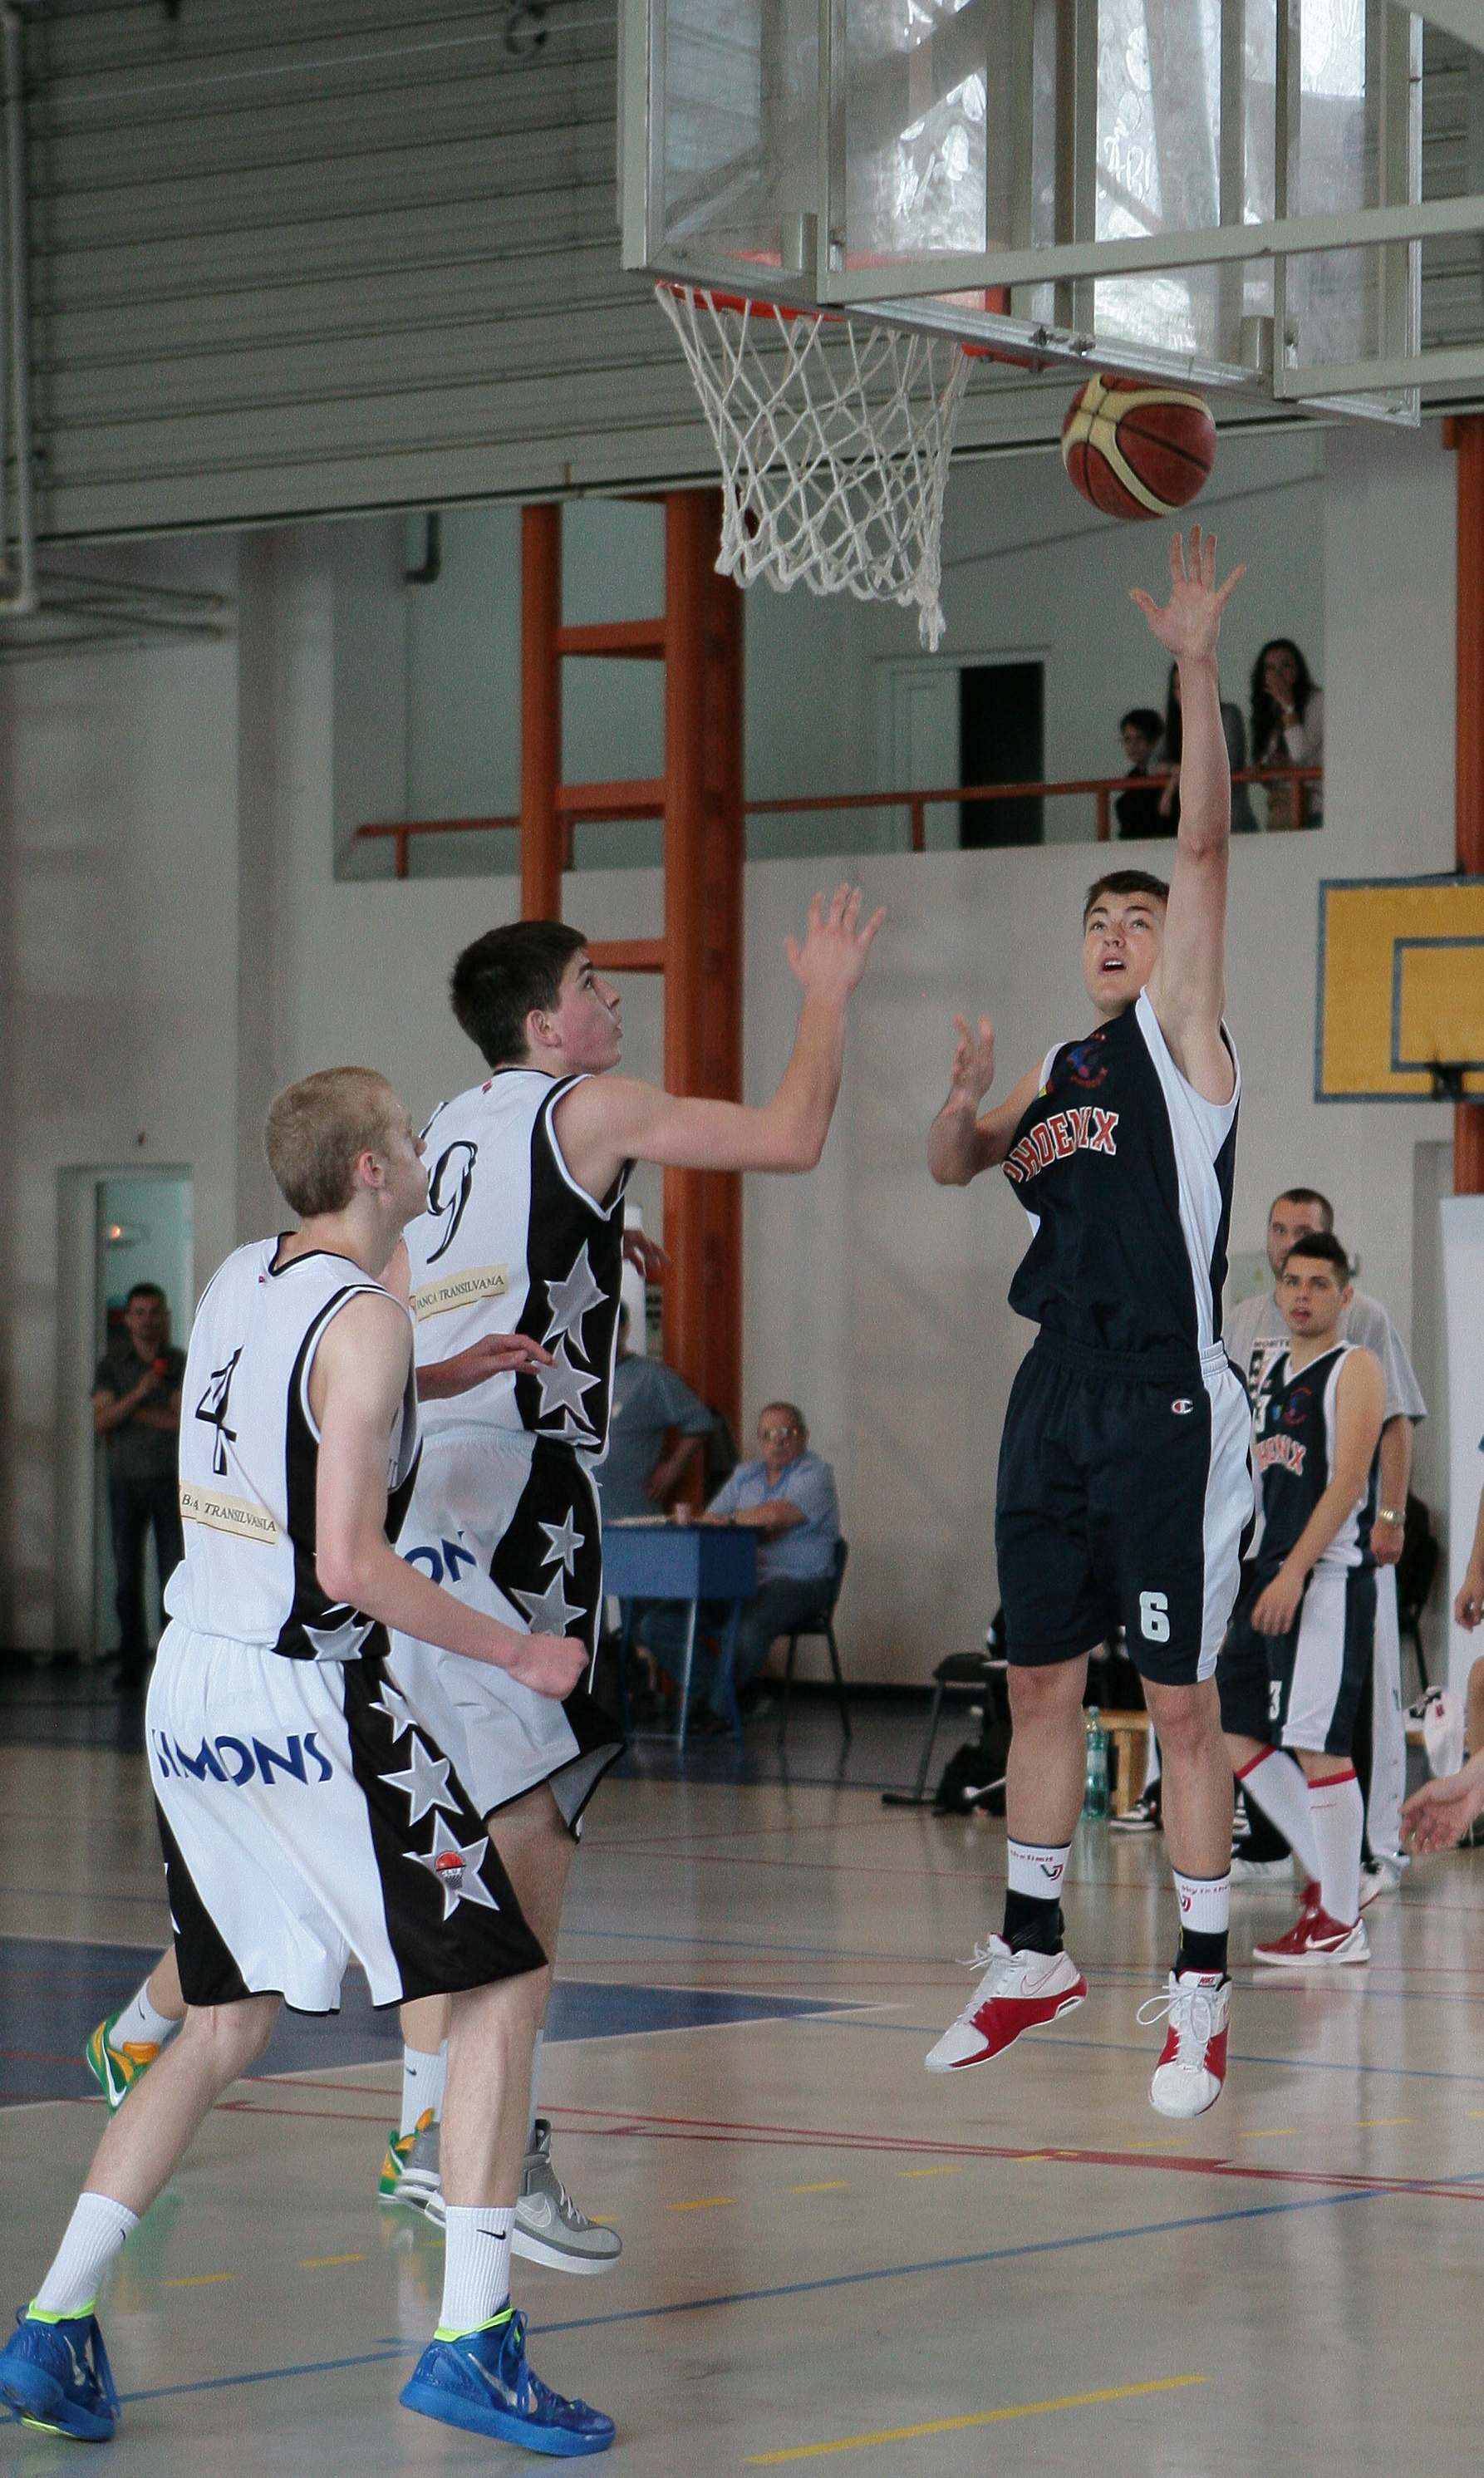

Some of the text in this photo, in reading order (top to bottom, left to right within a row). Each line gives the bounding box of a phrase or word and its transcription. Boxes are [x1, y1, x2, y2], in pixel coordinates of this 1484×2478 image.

[426, 1140, 479, 1265] 9
[194, 1344, 245, 1477] 4
[204, 1502, 277, 1532] TRANSILVANIA
[1139, 1591, 1171, 1643] 6
[1269, 1680, 1283, 1720] 3
